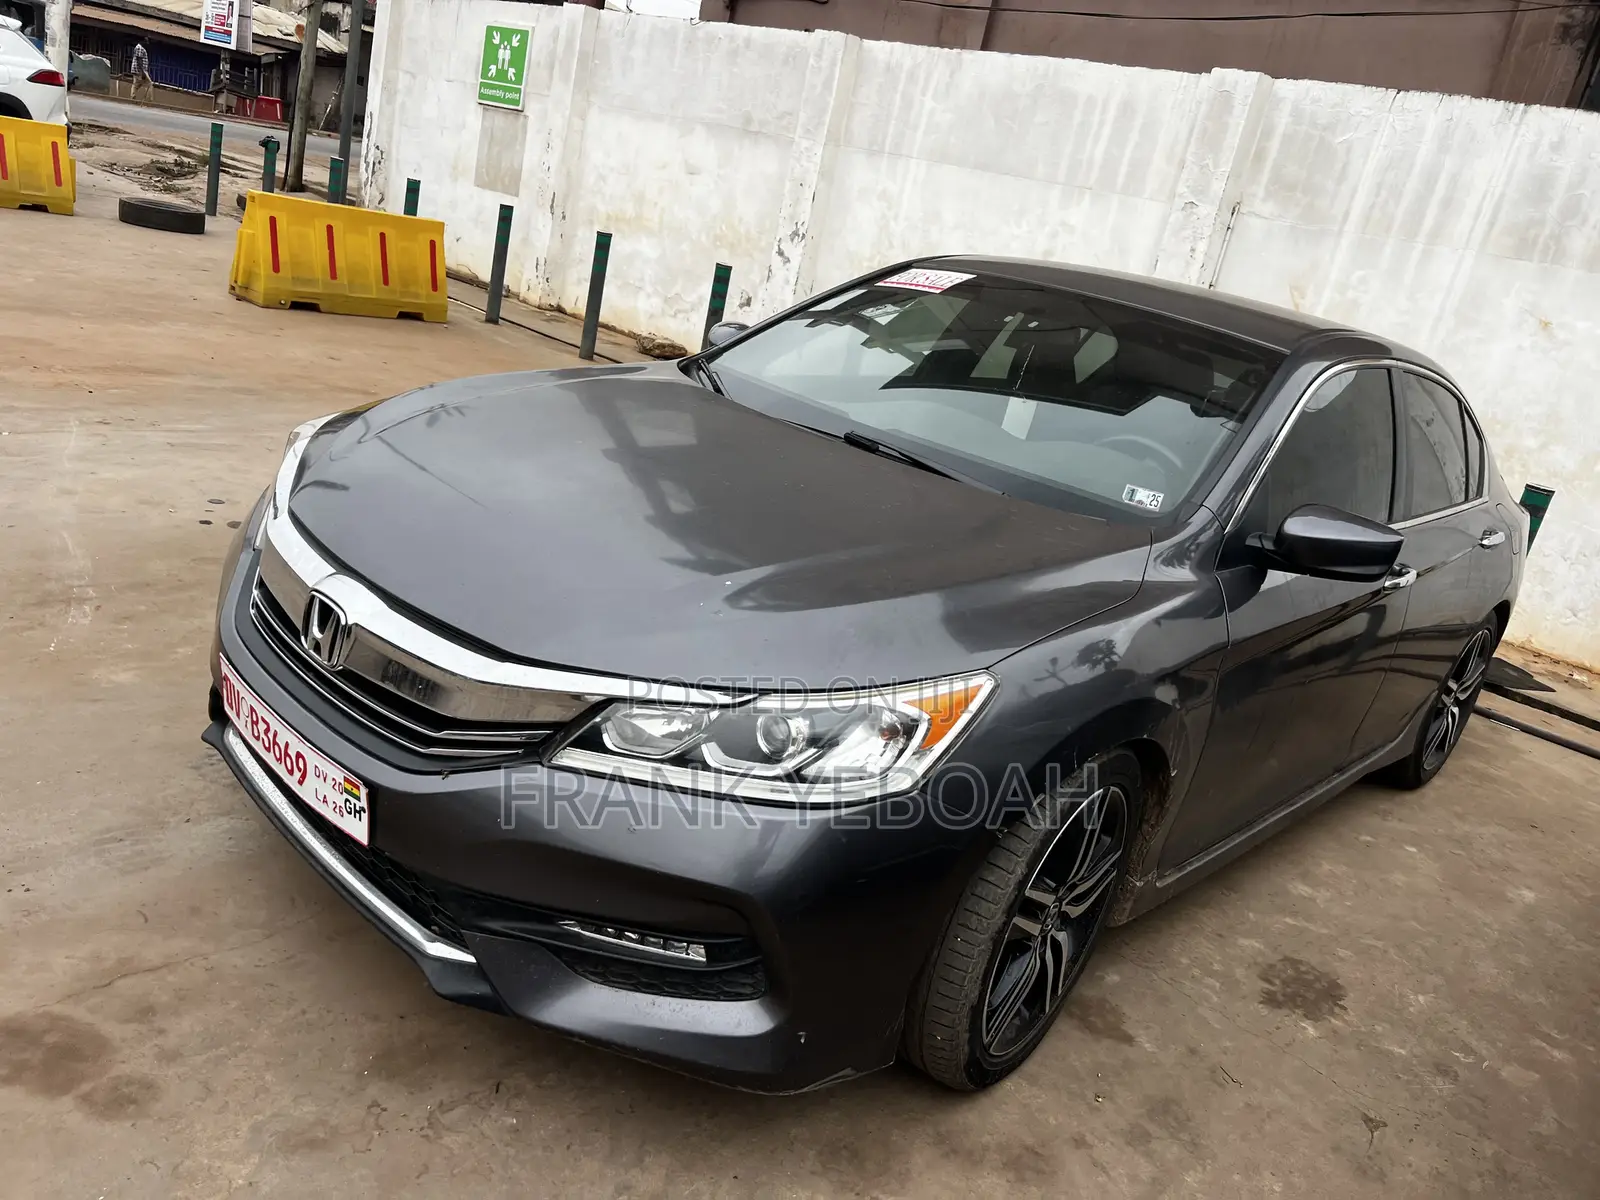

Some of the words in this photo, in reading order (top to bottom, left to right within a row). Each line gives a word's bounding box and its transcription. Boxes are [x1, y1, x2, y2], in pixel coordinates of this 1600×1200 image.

[480, 86, 505, 99] Assembly
[505, 91, 520, 100] point
[1149, 493, 1162, 507] 25
[249, 703, 308, 787] B3669
[314, 763, 328, 784] DV
[331, 777, 344, 796] 20
[315, 787, 330, 809] LA
[332, 800, 345, 818] 26
[344, 797, 363, 823] GH
